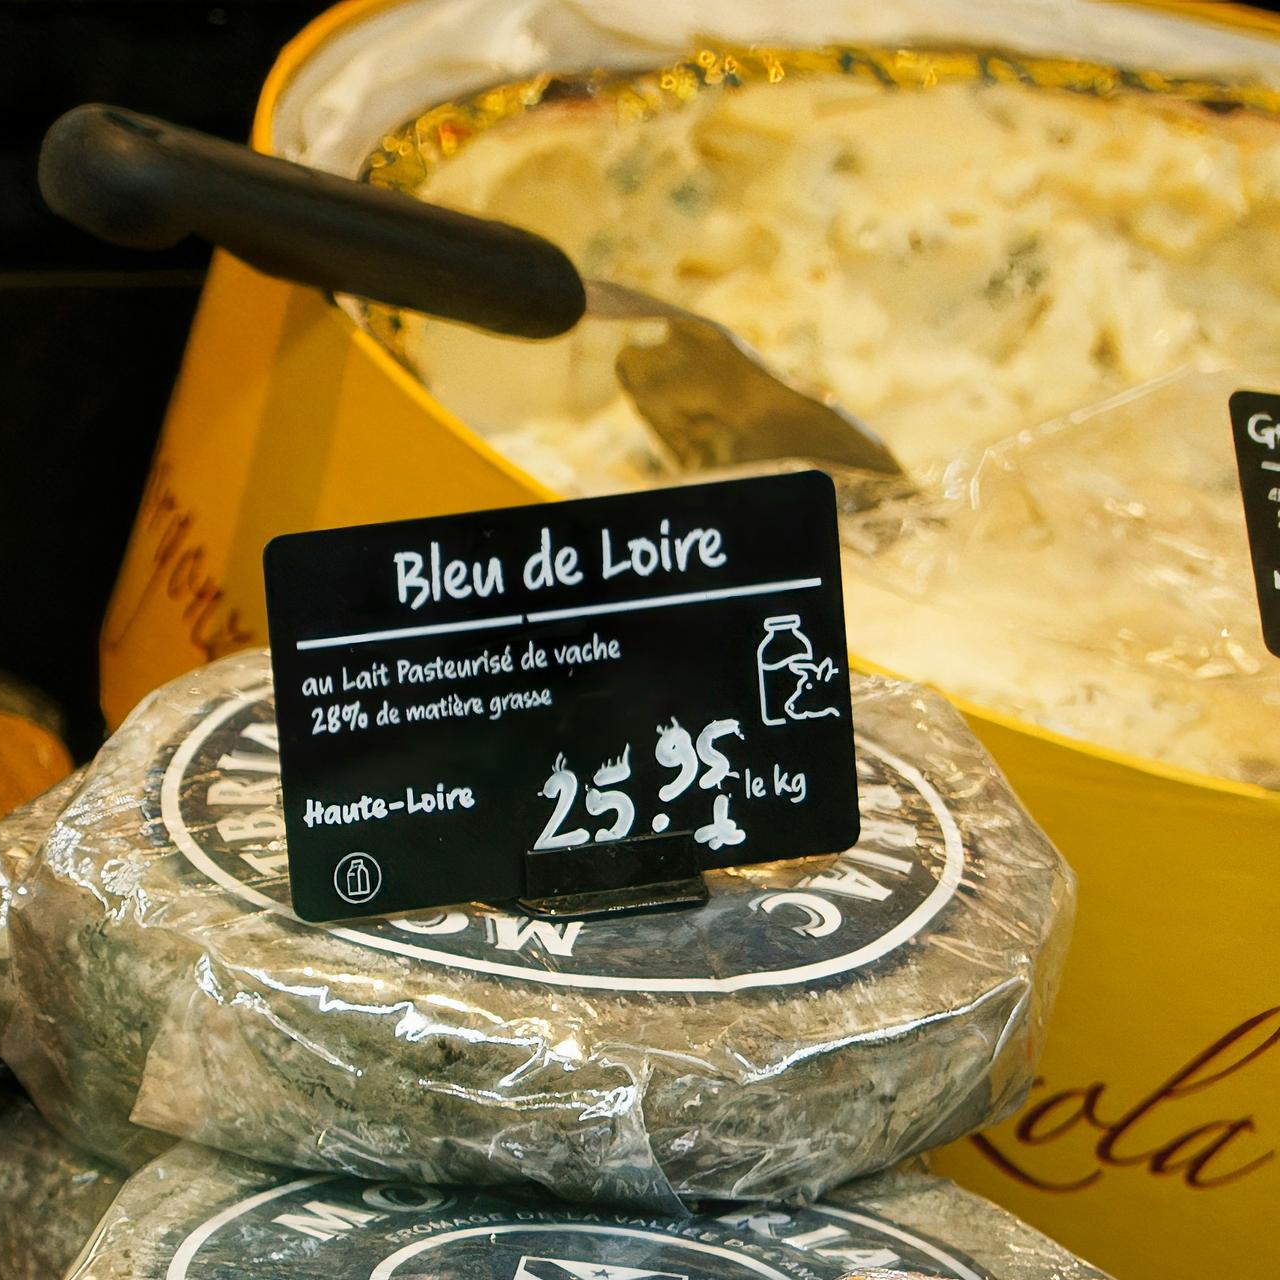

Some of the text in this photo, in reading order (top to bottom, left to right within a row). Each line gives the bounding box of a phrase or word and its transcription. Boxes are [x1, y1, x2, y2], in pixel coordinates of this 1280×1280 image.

[394, 519, 728, 610] Bleu de Loire
[302, 633, 622, 698] au Lait Pasteurisé de vache
[311, 686, 552, 735] 28% de matière grasse
[304, 785, 475, 828] Haute-Loire
[745, 766, 806, 802] le kg
